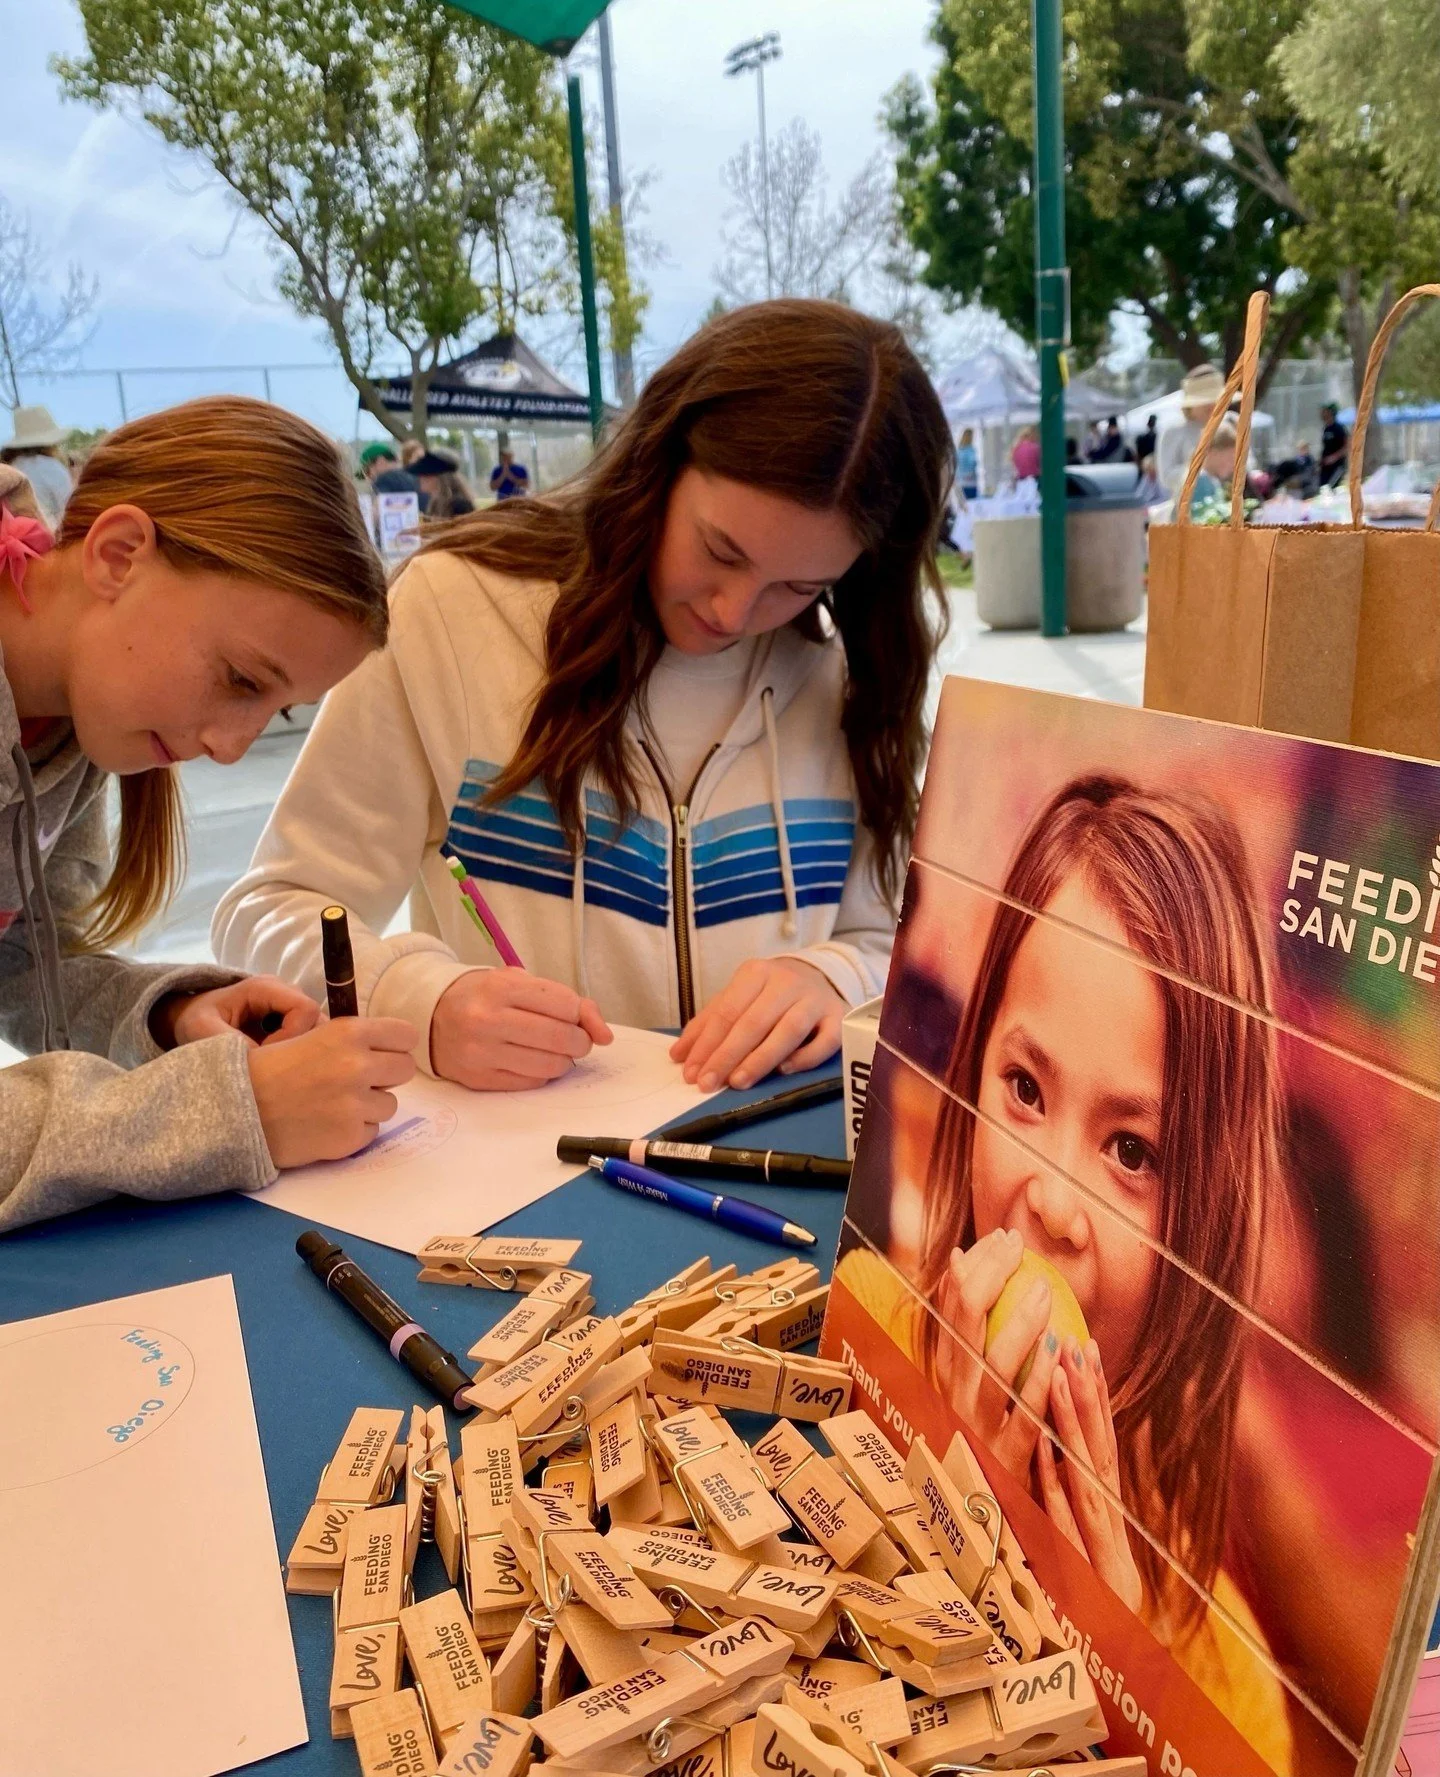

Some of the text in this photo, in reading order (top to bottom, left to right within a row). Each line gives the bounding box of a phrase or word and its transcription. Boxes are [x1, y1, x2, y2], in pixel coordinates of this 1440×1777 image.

[449, 392, 512, 411] ATHLETES
[1279, 898, 1357, 954] SAN
[497, 1243, 549, 1253] FEEDING
[492, 1309, 528, 1339] SAN DIEGO
[499, 1311, 536, 1342] FEEDING
[780, 1309, 824, 1338] FEEDING
[780, 1320, 823, 1347] SAN DIEG
[494, 1354, 539, 1384] SAN DIEGO
[499, 1357, 547, 1388] FEEDING
[538, 1346, 591, 1399] FEEDING
[541, 1352, 594, 1404] SAN DIEGO
[682, 1368, 750, 1389] FEEDING
[687, 1358, 752, 1378] SAN DIEGO
[842, 1338, 913, 1446] Thank you
[349, 1428, 378, 1477] FEEDING
[361, 1430, 388, 1478] SAN DIEGO
[501, 1448, 513, 1479] DIEGO
[598, 1429, 610, 1472] SAN DIEGO
[607, 1422, 621, 1467] FEEDING
[856, 1435, 898, 1483] FEEDING
[867, 1433, 892, 1459] DIEGO
[490, 1449, 506, 1507] FEEDING
[700, 1477, 737, 1522] SAN DIEGO
[711, 1473, 750, 1517] FEEDING
[927, 1477, 949, 1518] DIEGO
[797, 1497, 835, 1539] SAN DIEGO
[806, 1487, 845, 1531] FEEDING
[923, 1486, 962, 1557] FEEDING
[644, 1540, 717, 1564] SAN DIEGO
[949, 1518, 965, 1547] SAN
[364, 1535, 381, 1596] FEEDING
[377, 1534, 392, 1592] SAN DIEGO
[575, 1552, 616, 1598] SAN DIEGO
[585, 1551, 630, 1598] FEEDING
[637, 1547, 713, 1571] FEEDING
[840, 1583, 890, 1606] FEEDING
[953, 1600, 980, 1627] EGO
[435, 1626, 471, 1691] FEEDING
[450, 1622, 483, 1685] SAN DIEGO
[991, 1647, 1007, 1662] SA
[578, 1669, 657, 1709] SAN DIEGO
[586, 1676, 667, 1716] FEEDING
[1002, 1660, 1076, 1705] Love,
[1060, 1614, 1156, 1747] mission
[913, 1701, 945, 1720] SAN
[388, 1733, 411, 1777] DING
[404, 1729, 425, 1773] DIEGO
